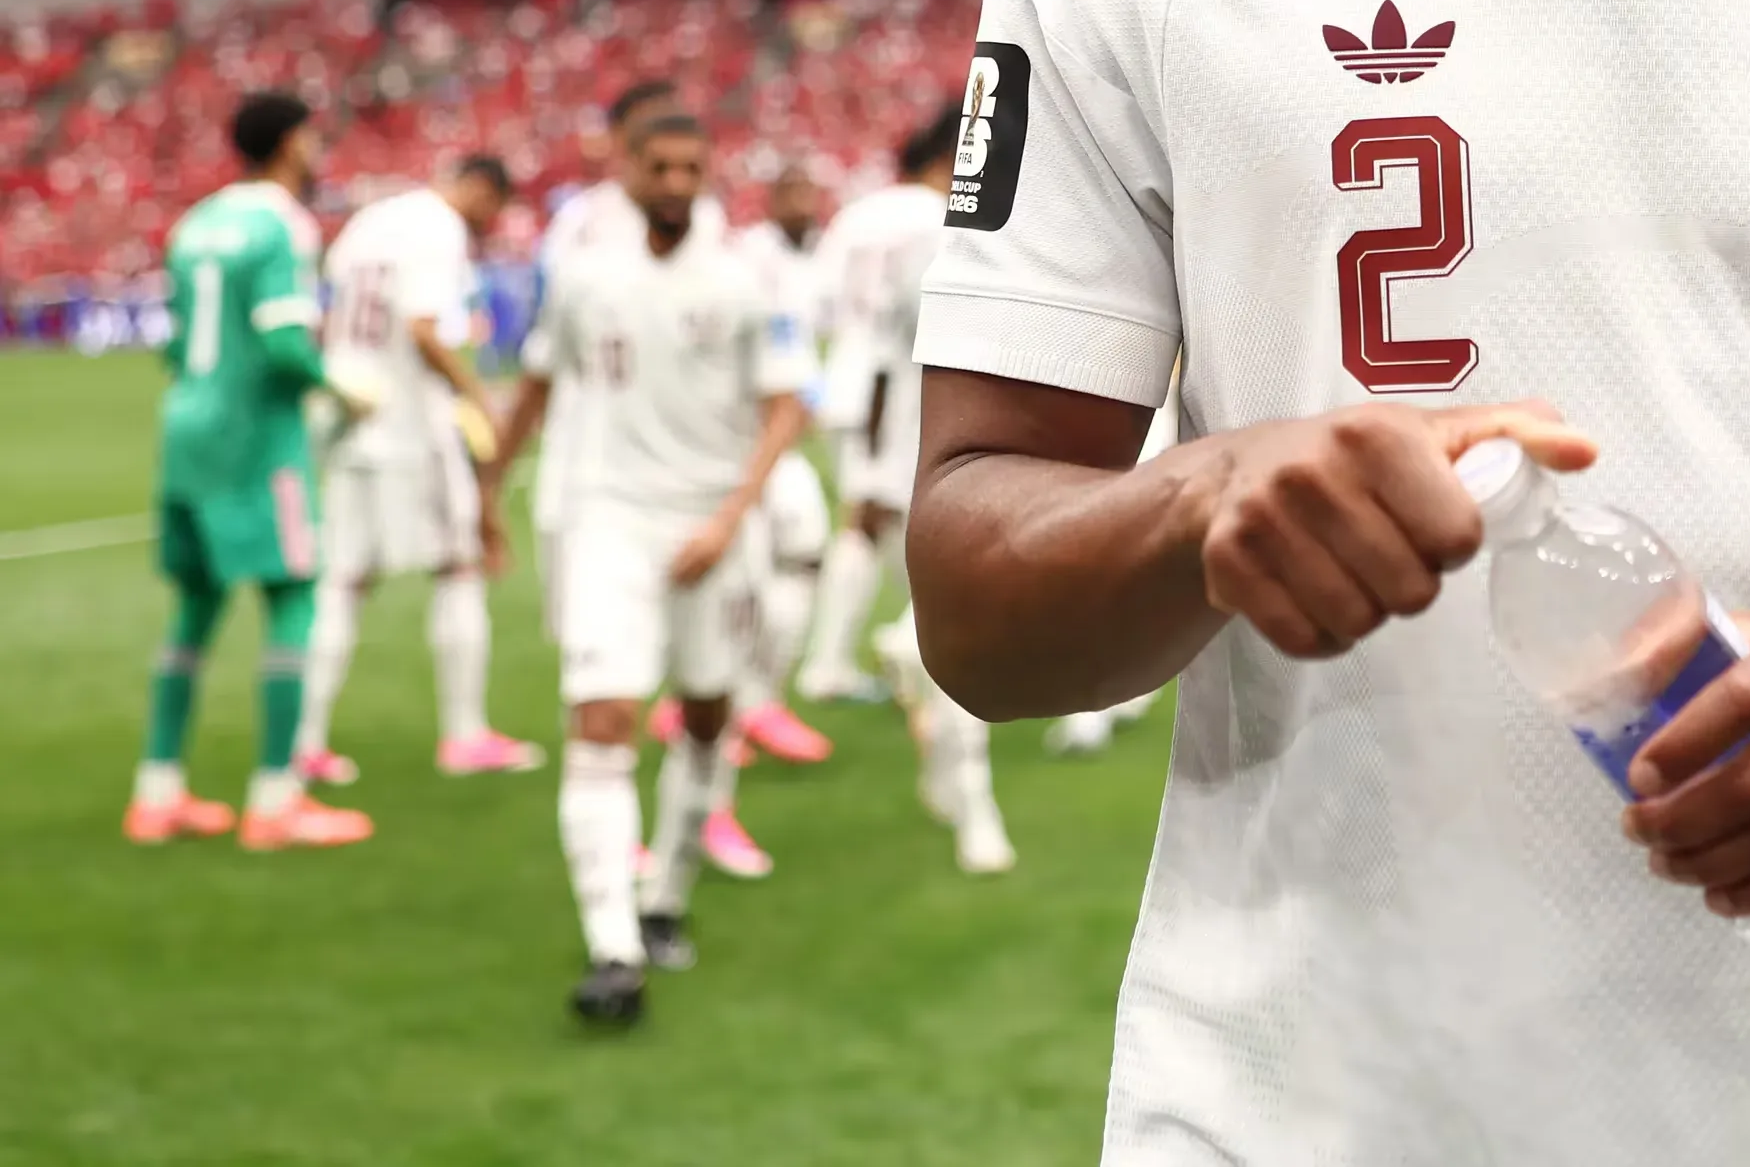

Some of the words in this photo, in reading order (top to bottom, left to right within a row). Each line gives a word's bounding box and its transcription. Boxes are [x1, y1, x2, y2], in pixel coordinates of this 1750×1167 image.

[958, 152, 973, 165] FIFA
[963, 181, 982, 194] CUP
[948, 193, 979, 214] 026
[1331, 116, 1479, 395] 2
[190, 261, 222, 375] 1
